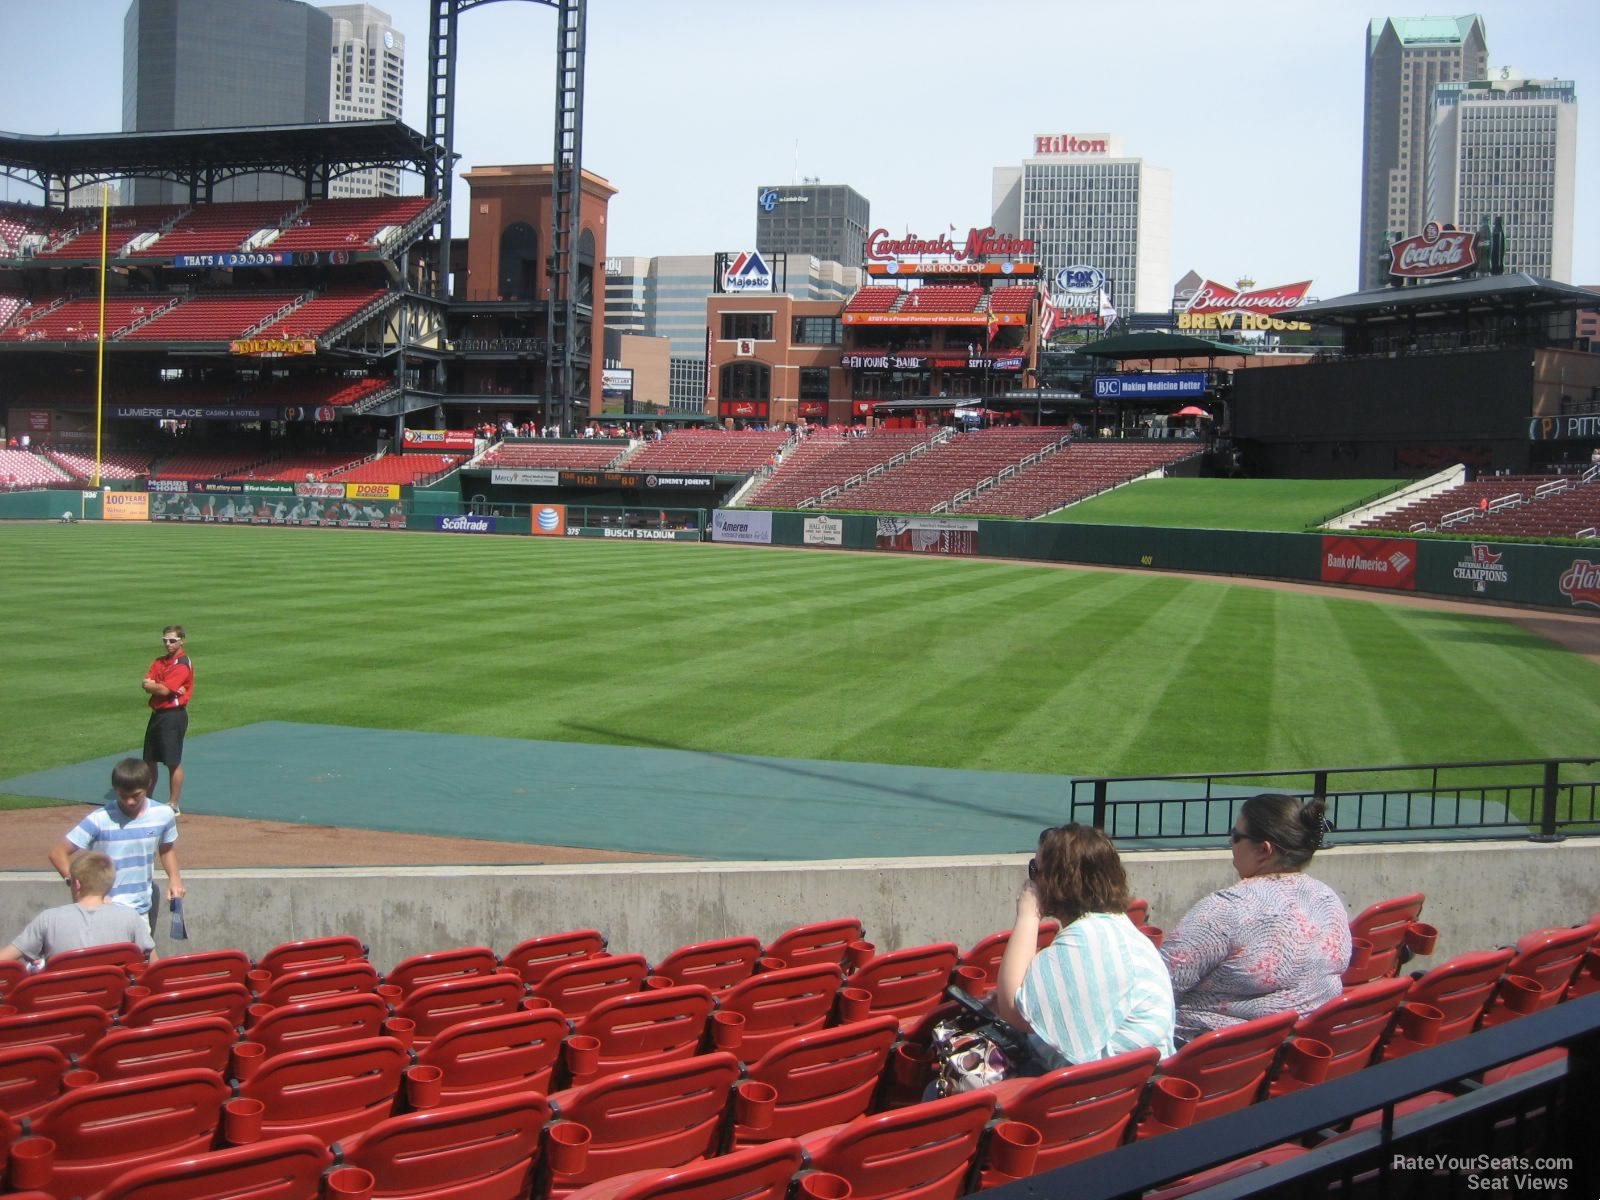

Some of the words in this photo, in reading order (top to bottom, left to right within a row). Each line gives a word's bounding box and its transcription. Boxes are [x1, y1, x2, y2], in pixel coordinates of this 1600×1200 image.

[1036, 135, 1106, 153] Hilton
[866, 228, 955, 261] Cardinals
[954, 227, 1035, 261] Nation
[183, 255, 214, 265] THAT'S
[218, 255, 224, 265] A
[915, 264, 937, 273] AT&T
[938, 264, 985, 273] ROOFTOP
[726, 276, 769, 289] Majestic
[1066, 271, 1094, 283] FOX
[1050, 294, 1099, 307] MIDWES
[1178, 313, 1236, 330] BREW
[863, 356, 889, 368] YOUNG
[968, 359, 983, 368] SEPT
[1098, 381, 1118, 395] BJC
[1122, 382, 1146, 392] Making
[1147, 381, 1178, 391] Medicine
[1179, 380, 1201, 390] Better
[118, 407, 163, 417] LUMIÈRE
[166, 408, 203, 417] PLACE
[494, 474, 514, 483] Mercy
[576, 475, 597, 485] 11:21
[684, 478, 711, 486] JOHN'S
[357, 486, 390, 494] DOBBS
[107, 495, 125, 504] 100
[441, 518, 488, 531] Scottrade
[722, 521, 749, 532] Ameren
[604, 528, 634, 538] BUSCH
[636, 529, 675, 539] STADIUM
[1327, 553, 1346, 568] Bank
[1346, 554, 1355, 569] of
[1355, 555, 1388, 572] America
[1457, 561, 1481, 569] NATIONAL
[1482, 562, 1505, 571] LEAGUE
[1453, 567, 1508, 582] CHAMPIONS
